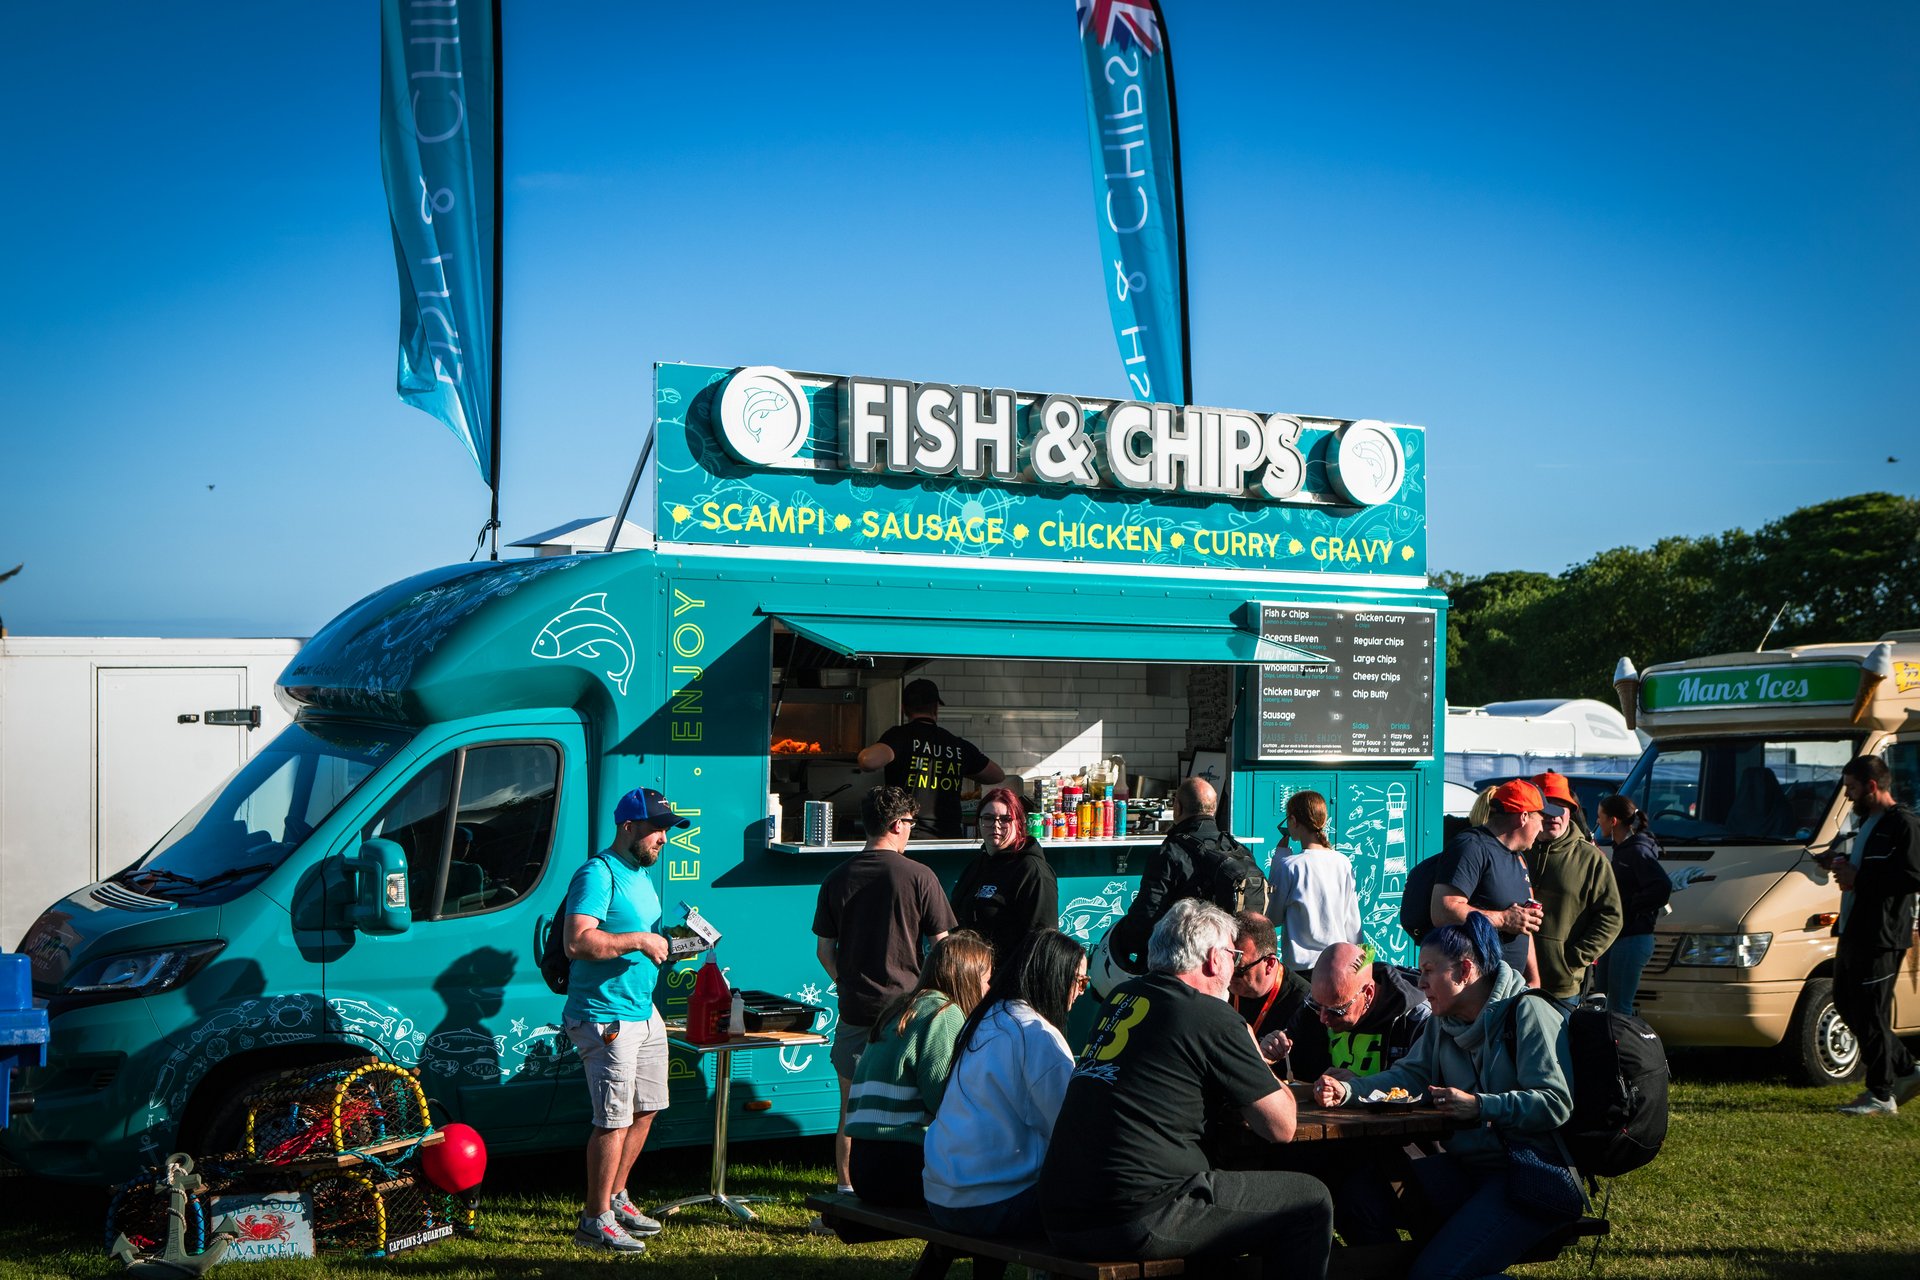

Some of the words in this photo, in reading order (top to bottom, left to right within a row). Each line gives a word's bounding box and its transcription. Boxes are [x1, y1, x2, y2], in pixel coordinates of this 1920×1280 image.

[852, 378, 1015, 477] FISH
[1033, 397, 1098, 484] &
[1106, 403, 1305, 497] CHIPS
[701, 501, 825, 536] SCAMPI
[861, 510, 1005, 545] SAUSAGE
[1038, 520, 1162, 553] CHICKEN
[1193, 529, 1280, 558] CURRY
[1310, 536, 1393, 564] GRAVY
[1264, 608, 1280, 618] Fish
[1281, 609, 1288, 618] &
[1289, 609, 1310, 620] Chips
[1354, 613, 1384, 622] Chicken
[1385, 614, 1406, 625] Curry
[1264, 633, 1293, 643] Oceans
[1294, 634, 1319, 643] Eleven
[1353, 636, 1383, 647] Regular
[1384, 637, 1405, 648] Chips
[671, 588, 705, 742] ENJOY
[1353, 654, 1376, 665] Large
[1377, 655, 1397, 665] Chips
[1264, 664, 1299, 673] Wholetail
[1352, 671, 1380, 682] Cheesy
[1380, 672, 1401, 682] Chips
[1263, 687, 1293, 696] Chicken
[1294, 688, 1321, 699] Burger
[1352, 689, 1370, 700] Chip
[1370, 690, 1389, 700] Butty
[1678, 677, 1750, 703] Manx
[1756, 673, 1809, 699] Ices
[1262, 711, 1296, 722] Sausage
[912, 739, 962, 760] PAUSE
[935, 761, 962, 776] EAT
[907, 774, 961, 791] ENJOY
[669, 801, 702, 881] EAT
[422, 1224, 453, 1242] QUARTERS
[227, 1240, 299, 1257] MARKET
